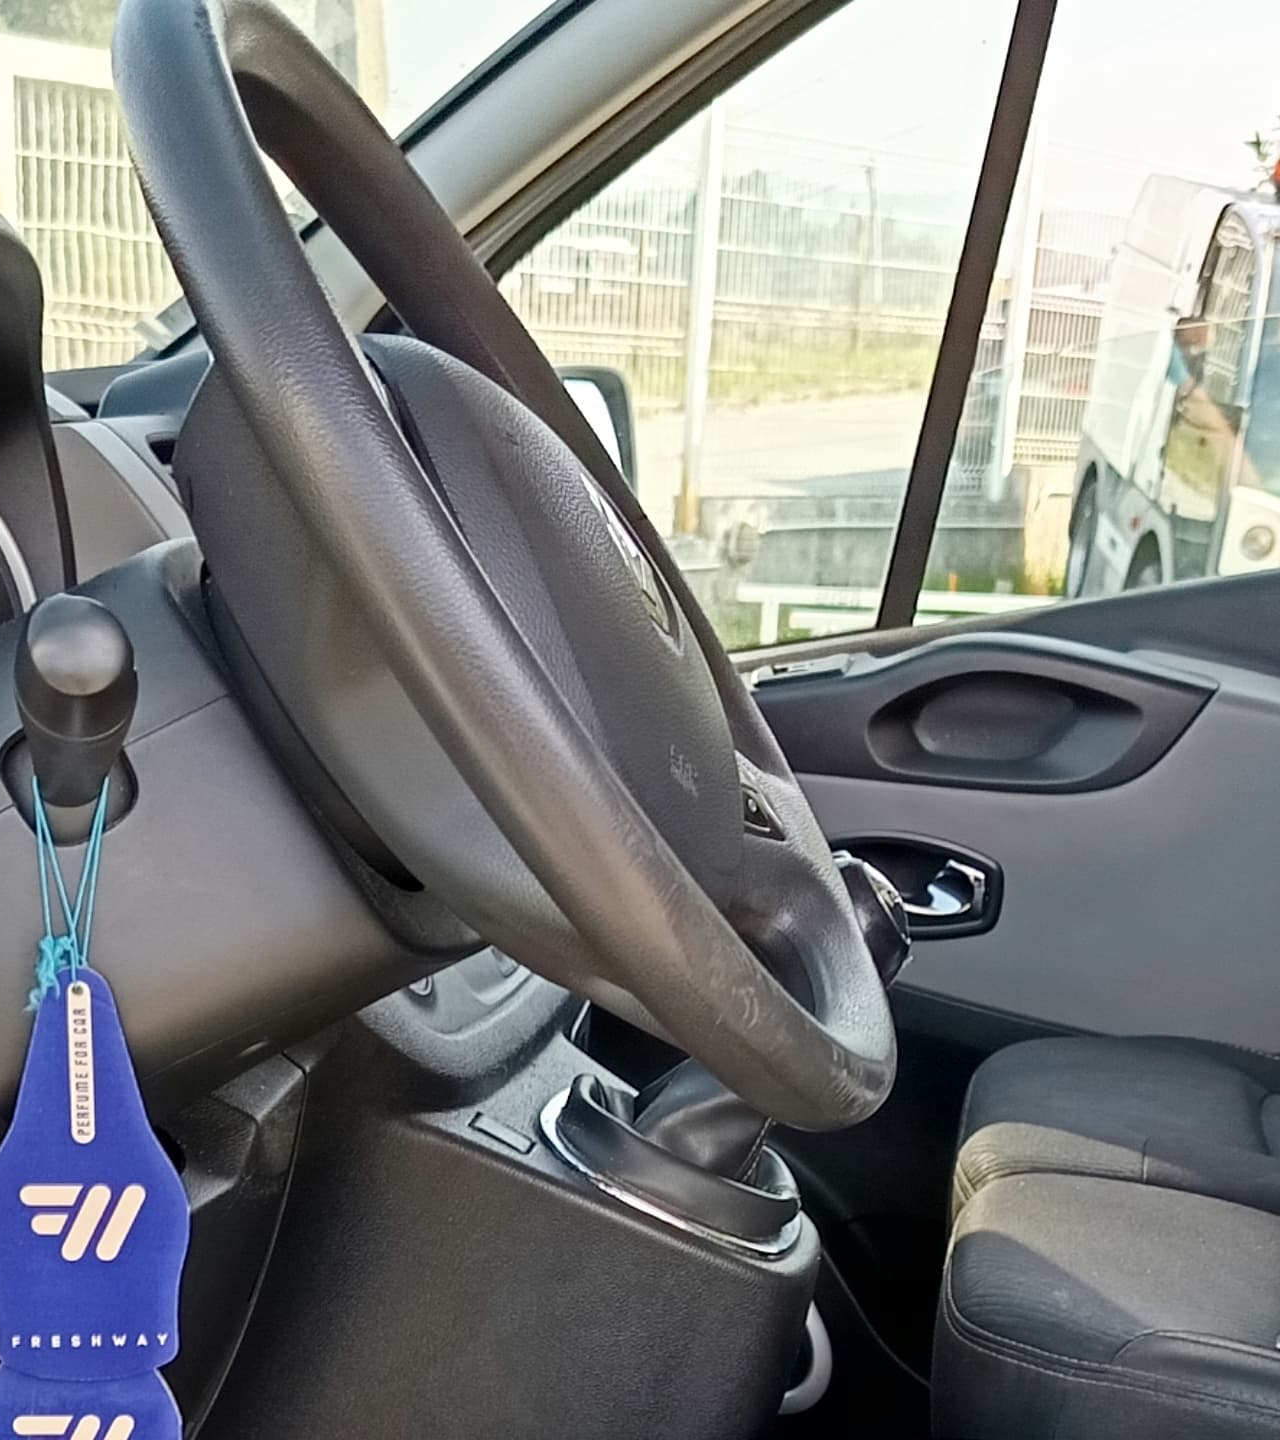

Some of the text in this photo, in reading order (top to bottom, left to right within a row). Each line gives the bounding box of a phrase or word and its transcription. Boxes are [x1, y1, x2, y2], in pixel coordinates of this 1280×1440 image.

[72, 1008, 91, 1137] PERFUME FOR CAR
[11, 1333, 169, 1349] FRESHWAY
